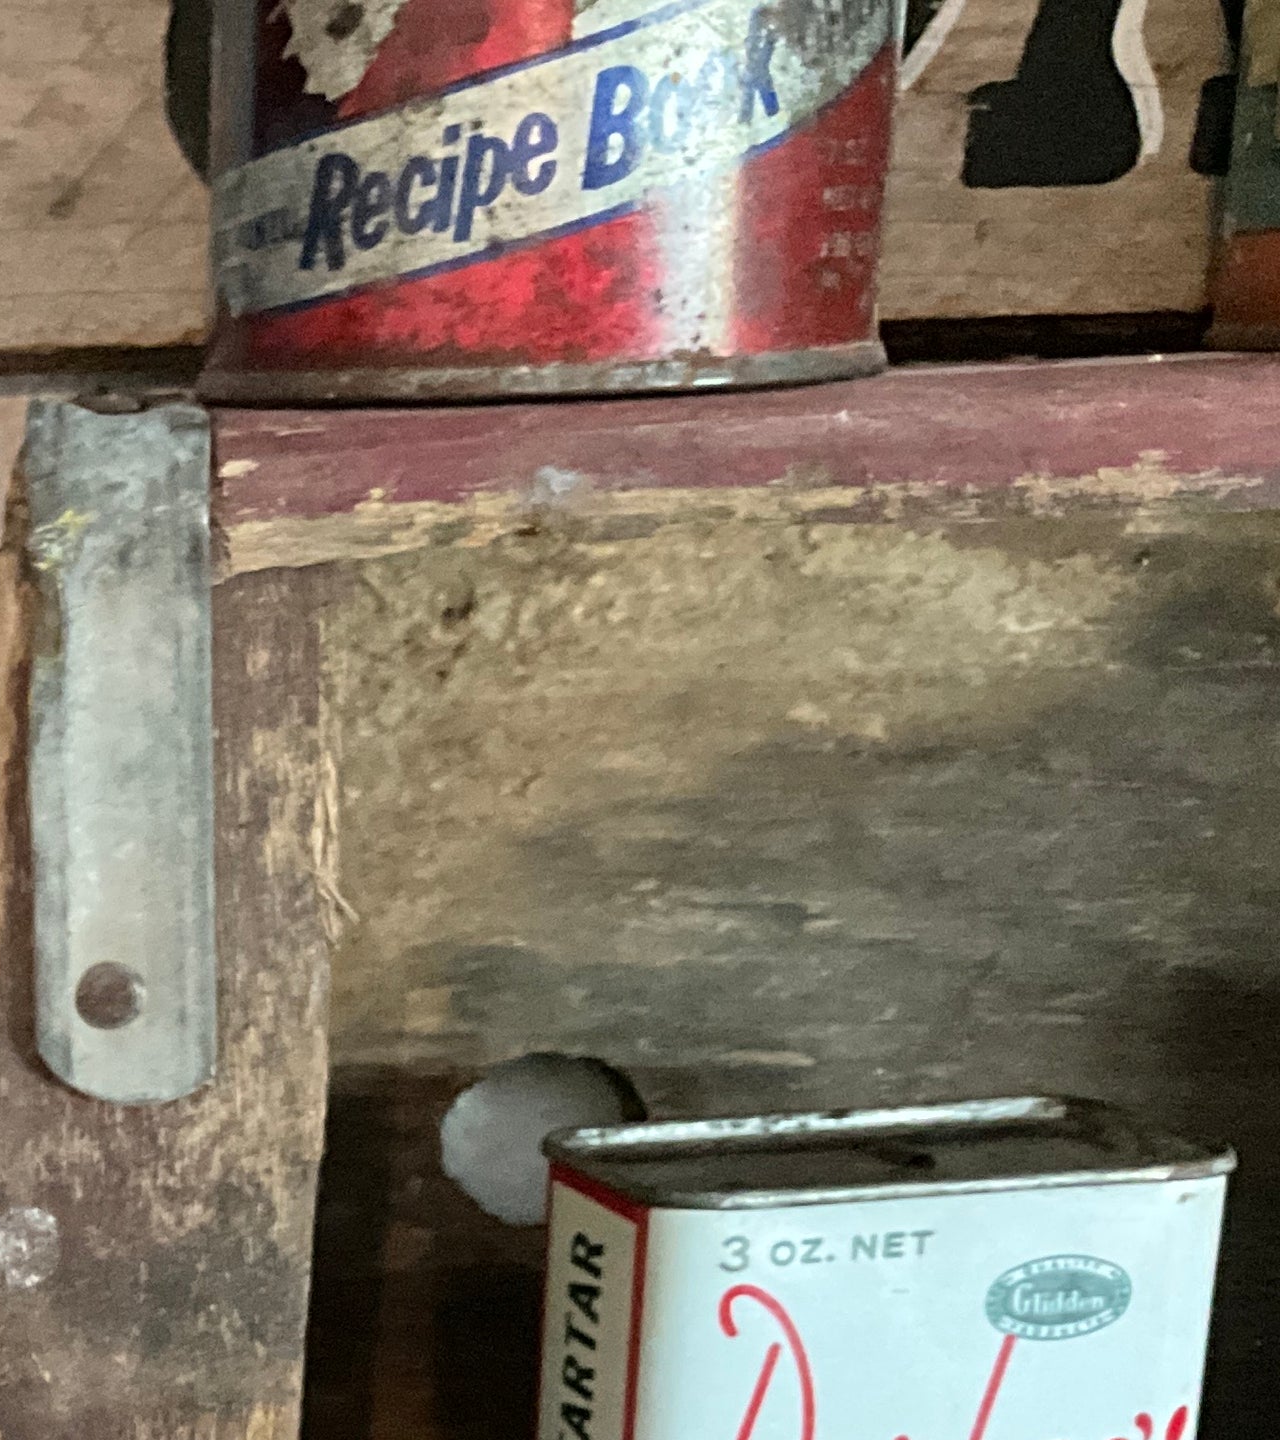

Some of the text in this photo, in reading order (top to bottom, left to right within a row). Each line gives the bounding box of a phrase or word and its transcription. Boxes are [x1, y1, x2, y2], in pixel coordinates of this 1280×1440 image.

[299, 111, 559, 271] Recipe
[719, 1229, 936, 1272] 3 OZ. NET
